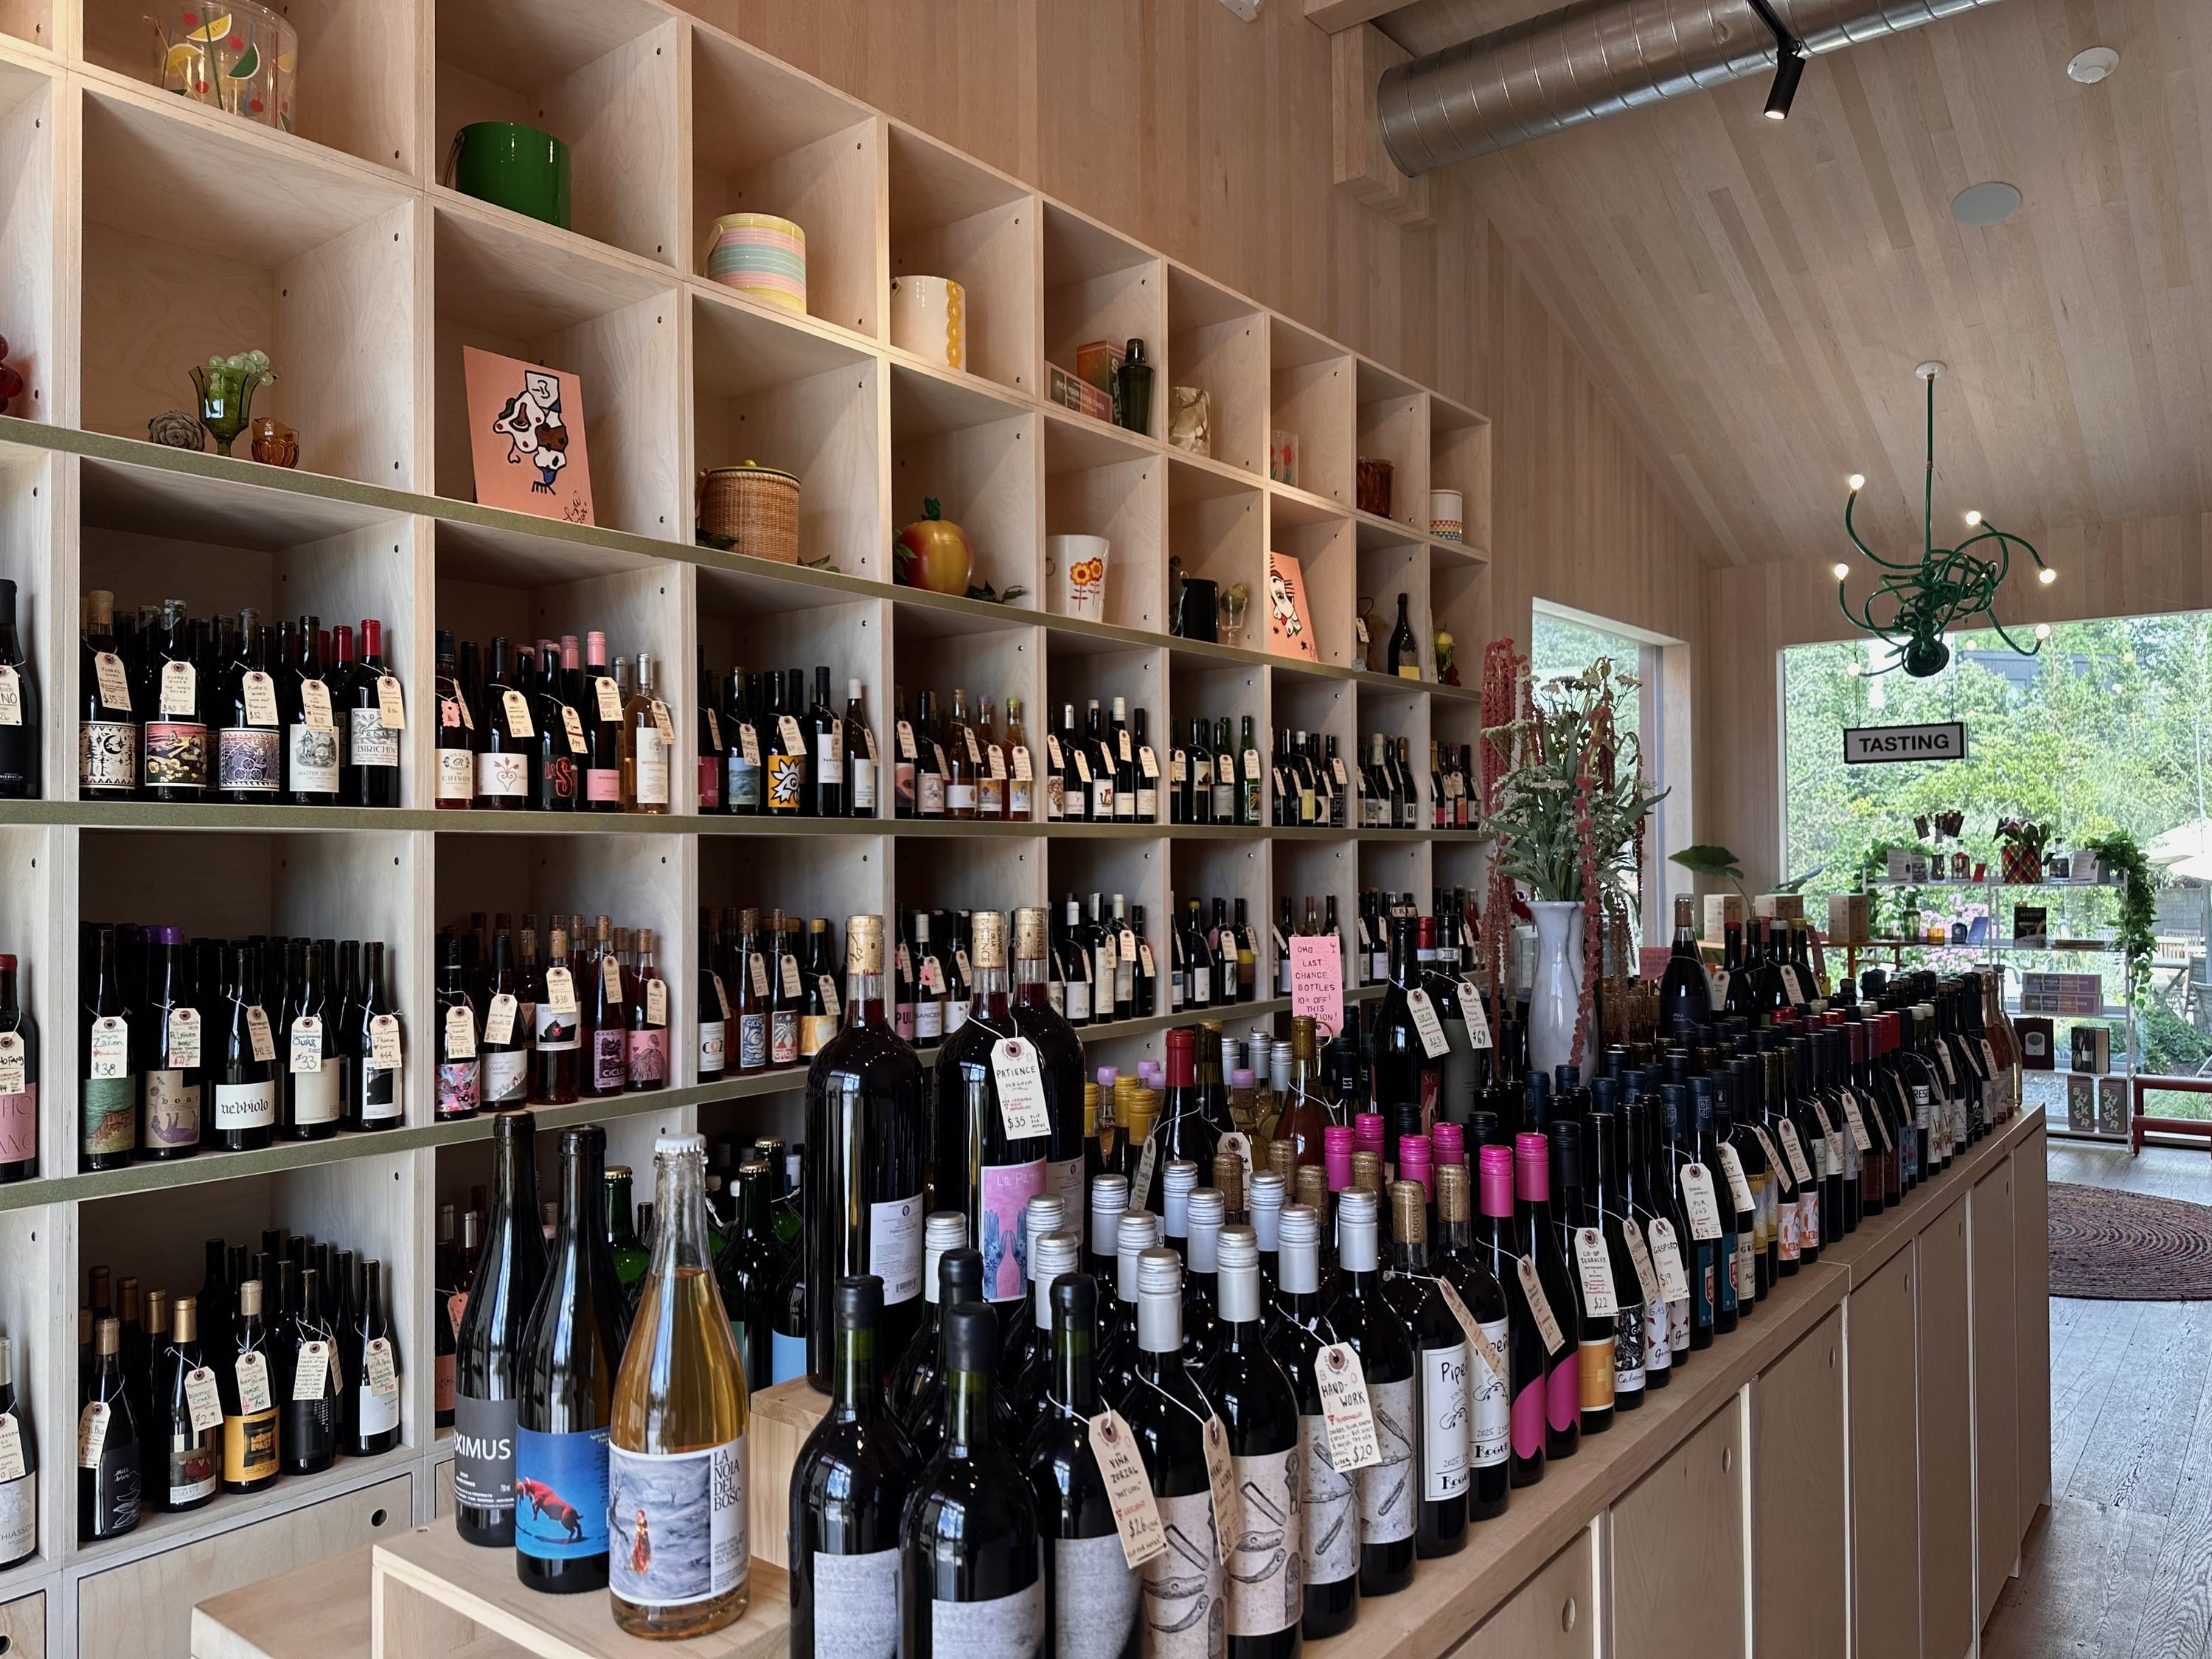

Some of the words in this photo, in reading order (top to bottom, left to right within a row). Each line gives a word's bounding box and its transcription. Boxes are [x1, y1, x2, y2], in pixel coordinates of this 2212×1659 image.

[1859, 734, 1949, 753] TASTING
[1037, 913, 1045, 957] PATIENCE
[1302, 959, 1322, 967] LAST
[1298, 984, 1335, 992] BOTTLES
[554, 995, 568, 1005] $30
[1298, 1012, 1338, 1022] TION!
[1429, 1035, 1442, 1047] $25
[295, 1054, 317, 1071] $33
[996, 1065, 1036, 1079] PATIENCE
[1006, 1080, 1033, 1089] MAGNUM
[221, 1098, 269, 1115] nebbiolo
[2073, 1087, 2090, 1127] SHAKER
[2102, 1088, 2119, 1130] SHAKER
[1008, 1115, 1026, 1131] $35
[1653, 1242, 1678, 1254] GASPARD
[1660, 1273, 1673, 1289] $19
[1593, 1296, 1609, 1312] $22
[1321, 1381, 1349, 1399] HAND-
[1339, 1391, 1366, 1408] WORK
[195, 1411, 216, 1427] $29
[1477, 1427, 1493, 1438] 2025
[714, 1448, 729, 1467] LA
[1109, 1453, 1130, 1469] VIÑA
[1352, 1444, 1373, 1466] $20
[1443, 1455, 1460, 1468] 2025
[714, 1459, 740, 1482] NOIA
[1110, 1466, 1139, 1484] ZORZAL
[714, 1475, 736, 1497] DEL
[714, 1487, 742, 1512] BOSC
[0, 1523, 35, 1541] HIASSON
[1128, 1516, 1147, 1541] $26
